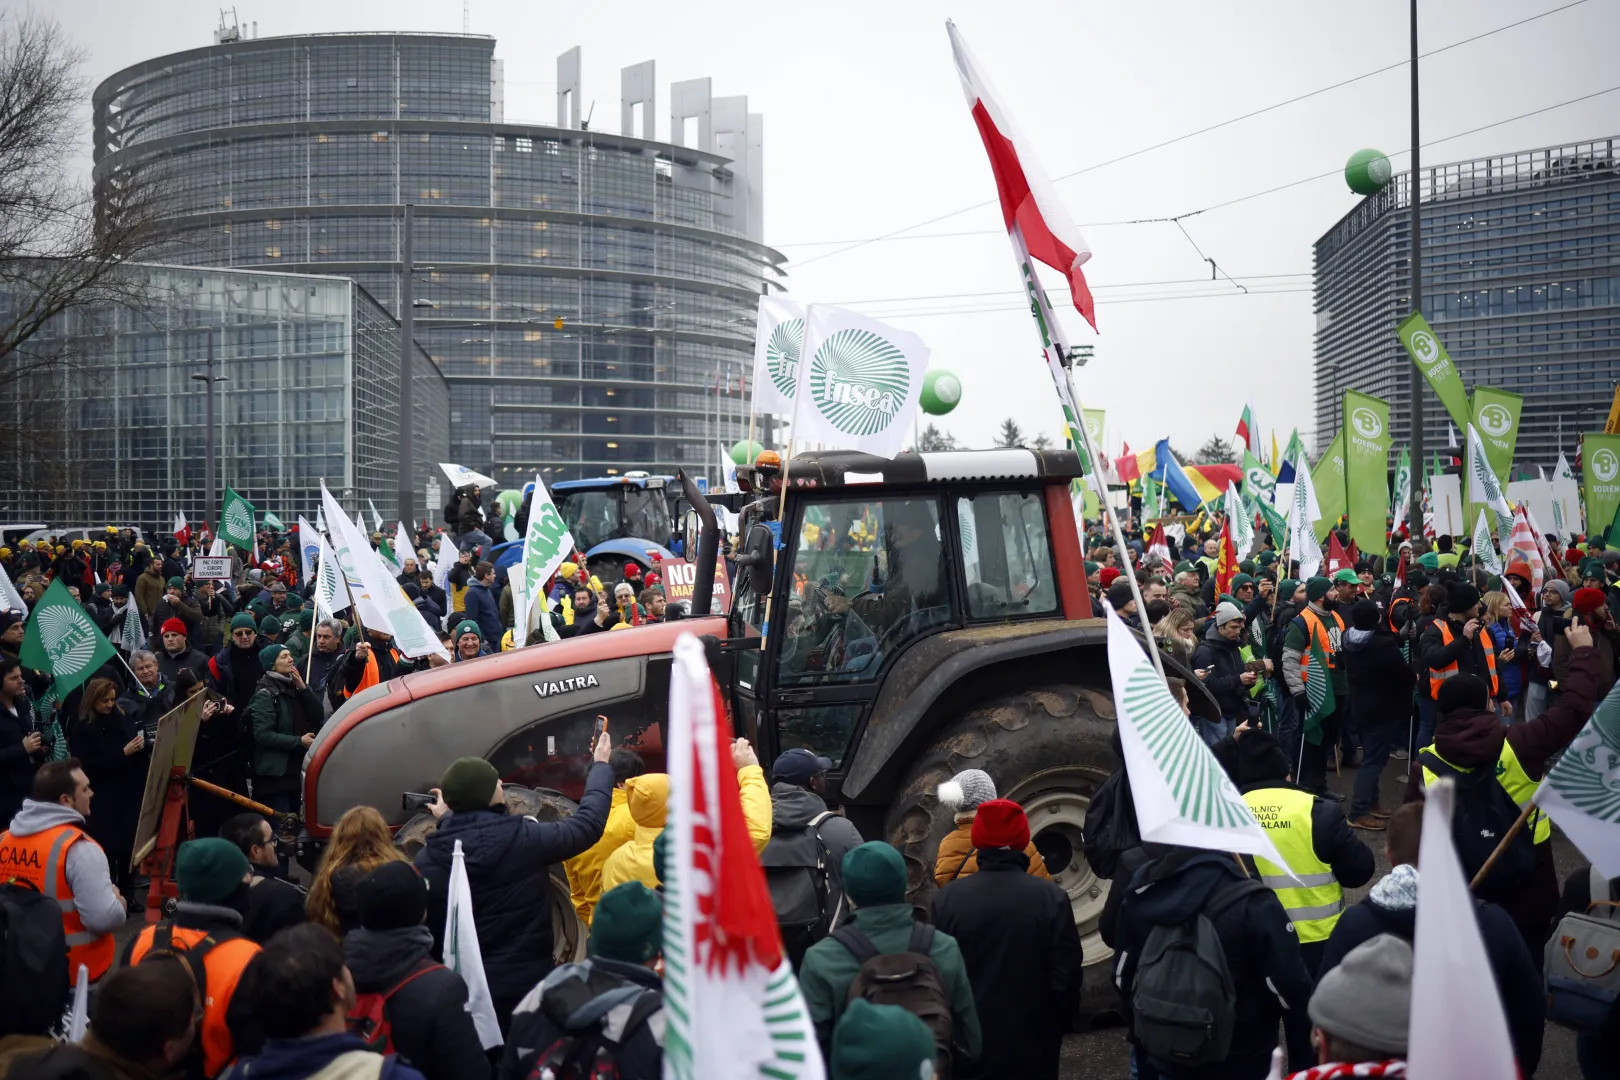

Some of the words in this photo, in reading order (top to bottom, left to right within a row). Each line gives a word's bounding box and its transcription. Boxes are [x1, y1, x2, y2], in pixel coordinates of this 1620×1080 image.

[822, 370, 895, 414] fnsea
[1352, 436, 1382, 452] BOEREN
[46, 622, 90, 662] fnse
[532, 674, 600, 699] VALTRA
[1249, 805, 1283, 813] OLNICY
[1260, 820, 1291, 829] AŁAMI
[0, 846, 41, 869] CAAA
